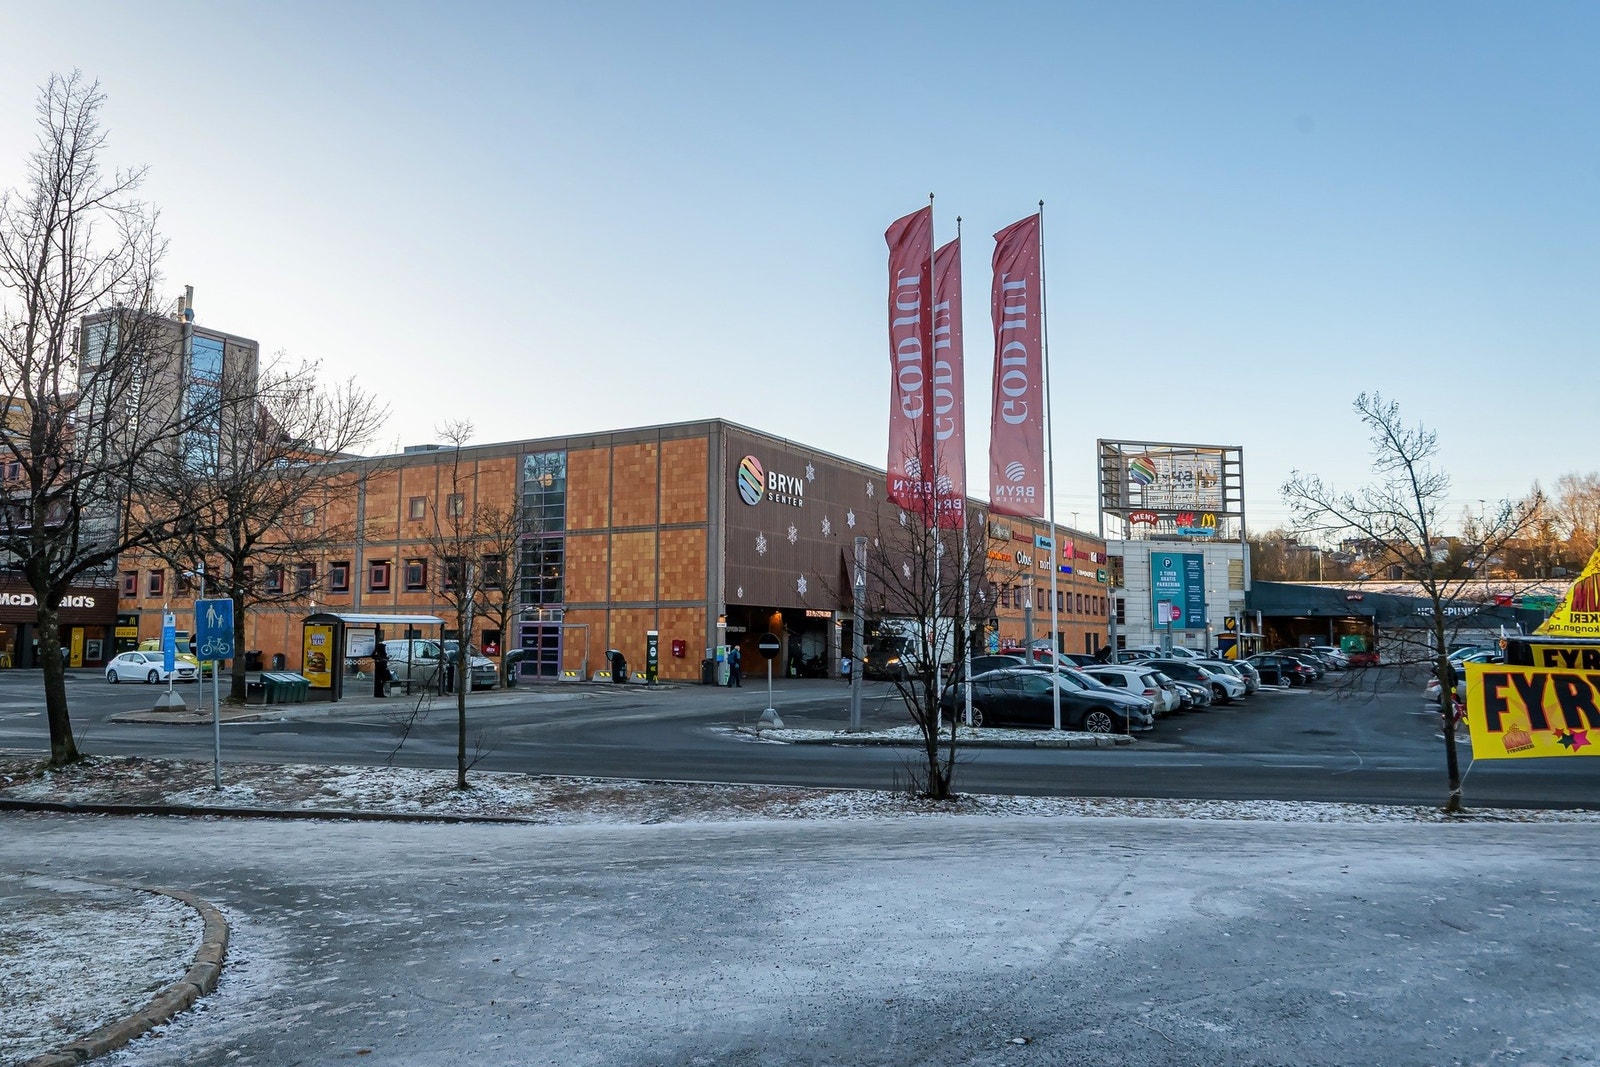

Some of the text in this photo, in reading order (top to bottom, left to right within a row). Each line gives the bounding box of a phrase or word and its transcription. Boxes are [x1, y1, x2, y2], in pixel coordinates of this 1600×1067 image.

[768, 471, 803, 497] BRYN
[768, 492, 803, 508] SENTER
[1133, 513, 1156, 523] MENY
[1039, 556, 1052, 570] norl
[0, 593, 96, 609] McDald's
[1417, 607, 1480, 616] HENEPUNKT
